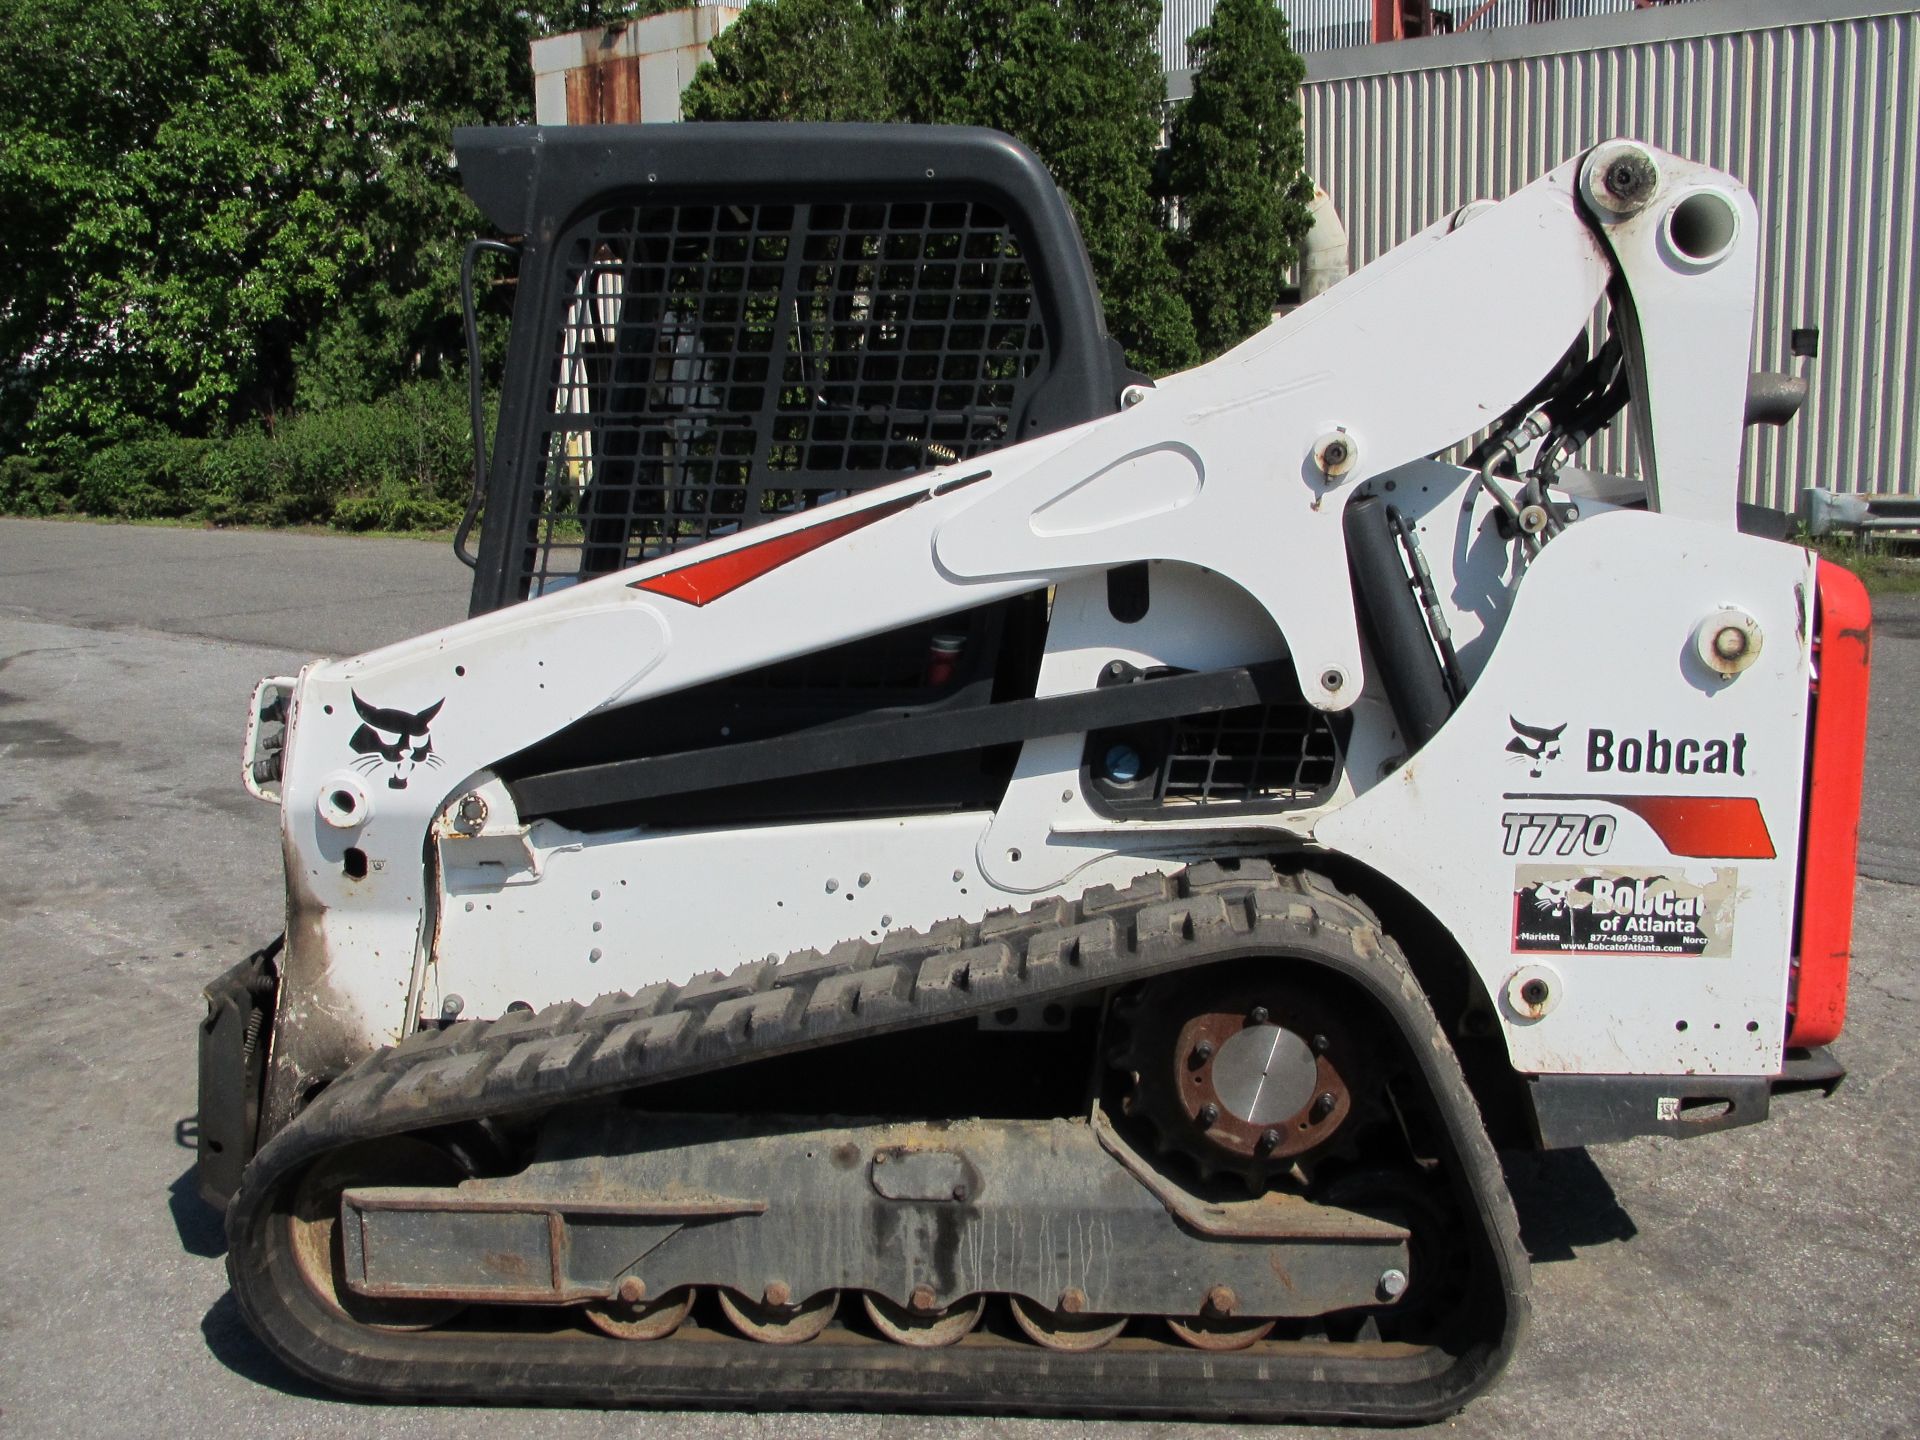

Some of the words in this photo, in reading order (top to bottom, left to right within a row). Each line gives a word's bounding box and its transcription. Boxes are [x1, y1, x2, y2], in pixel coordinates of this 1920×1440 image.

[1587, 728, 1747, 777] Bobcat
[1502, 812, 1617, 856] T770
[1599, 915, 1621, 932] of
[1625, 916, 1696, 933] Atlanta
[1521, 932, 1560, 941] Marietta
[1590, 934, 1655, 943] 877-469-5933
[1560, 942, 1683, 953] www.BobcatofAtlanta.com
